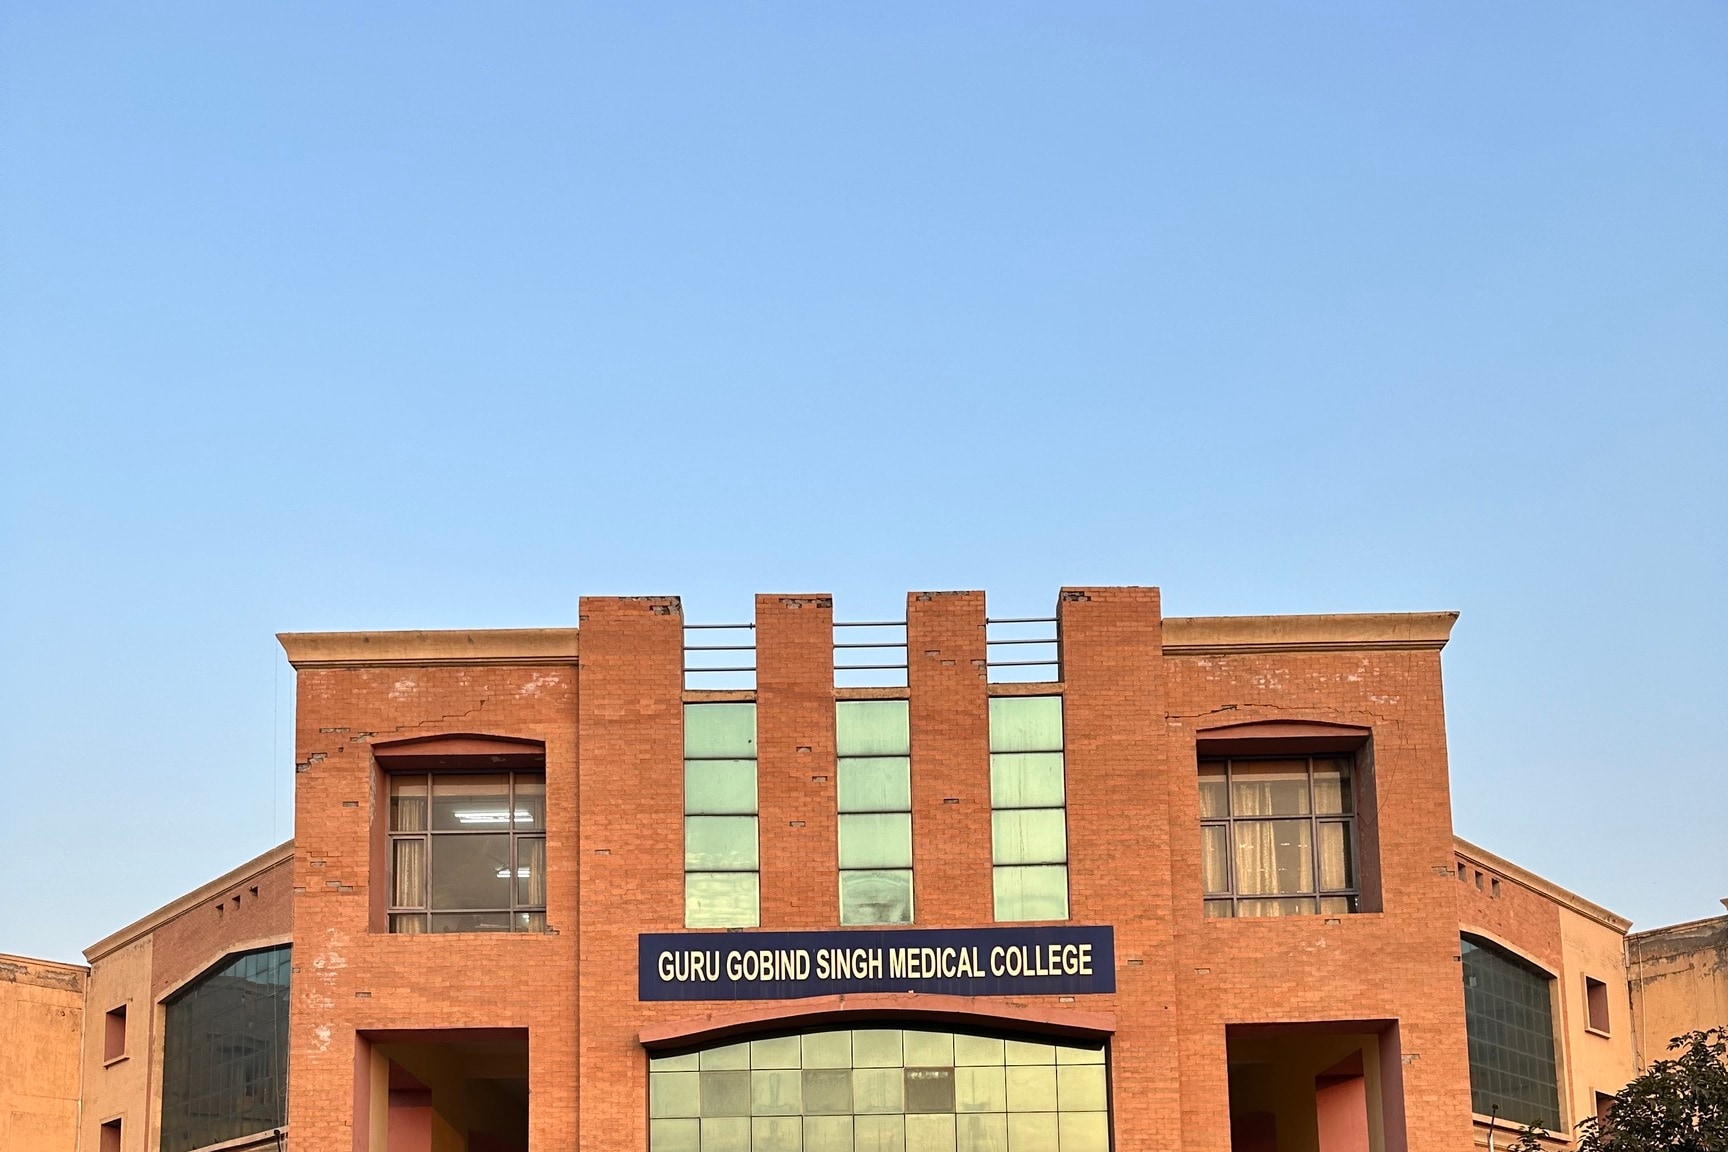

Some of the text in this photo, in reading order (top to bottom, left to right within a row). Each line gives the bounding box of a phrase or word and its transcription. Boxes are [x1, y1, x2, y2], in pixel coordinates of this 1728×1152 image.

[658, 943, 1093, 982] GURU GOBIND SINGH MEDICAL COLLEGE
